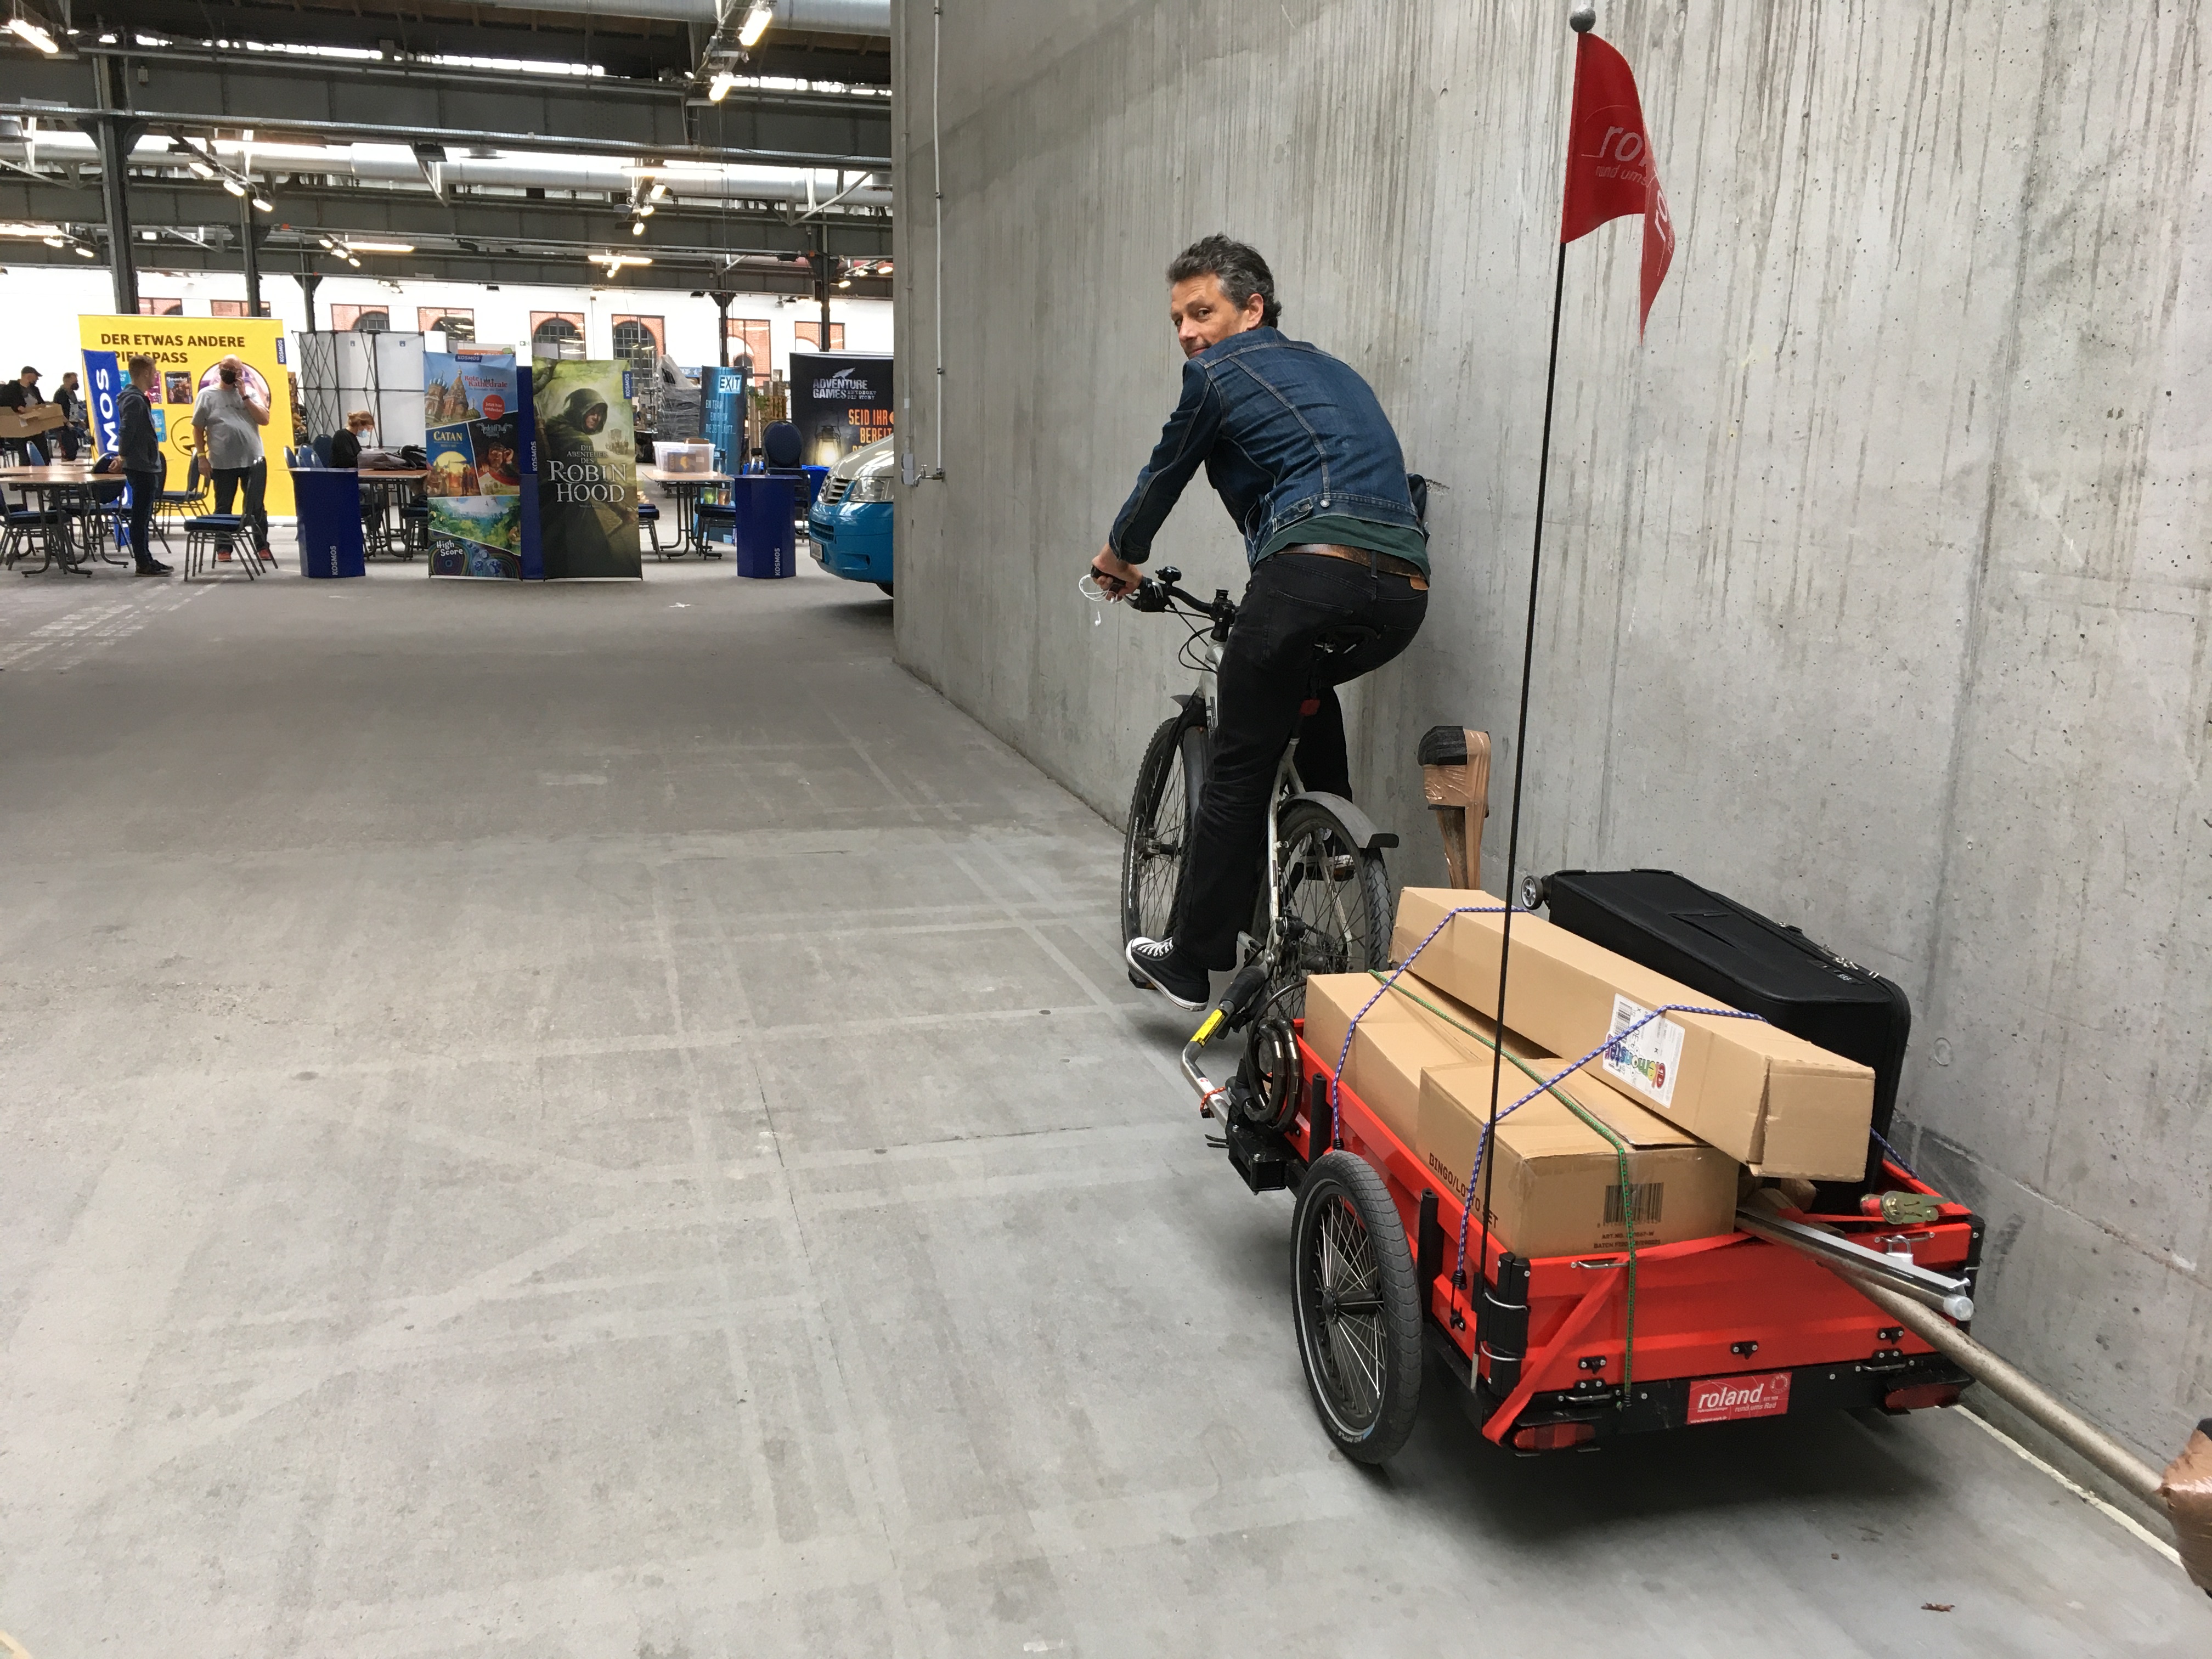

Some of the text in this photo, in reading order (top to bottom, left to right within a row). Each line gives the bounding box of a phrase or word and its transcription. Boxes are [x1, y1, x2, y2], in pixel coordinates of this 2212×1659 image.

[101, 334, 245, 347] DER ETWAS ANDERE
[468, 380, 508, 388] Kathedrale
[720, 377, 740, 392] EXIT
[812, 378, 868, 390] ADVENTURE
[812, 388, 847, 399] GAMES
[848, 409, 888, 425] SEID IHR
[433, 431, 462, 441] CATAN
[546, 460, 628, 483] ROBIN
[556, 483, 625, 503] HOOD
[436, 539, 455, 550] High
[440, 548, 463, 557] Score
[330, 545, 338, 575] KOSMOS
[1698, 1383, 1764, 1409] roland
